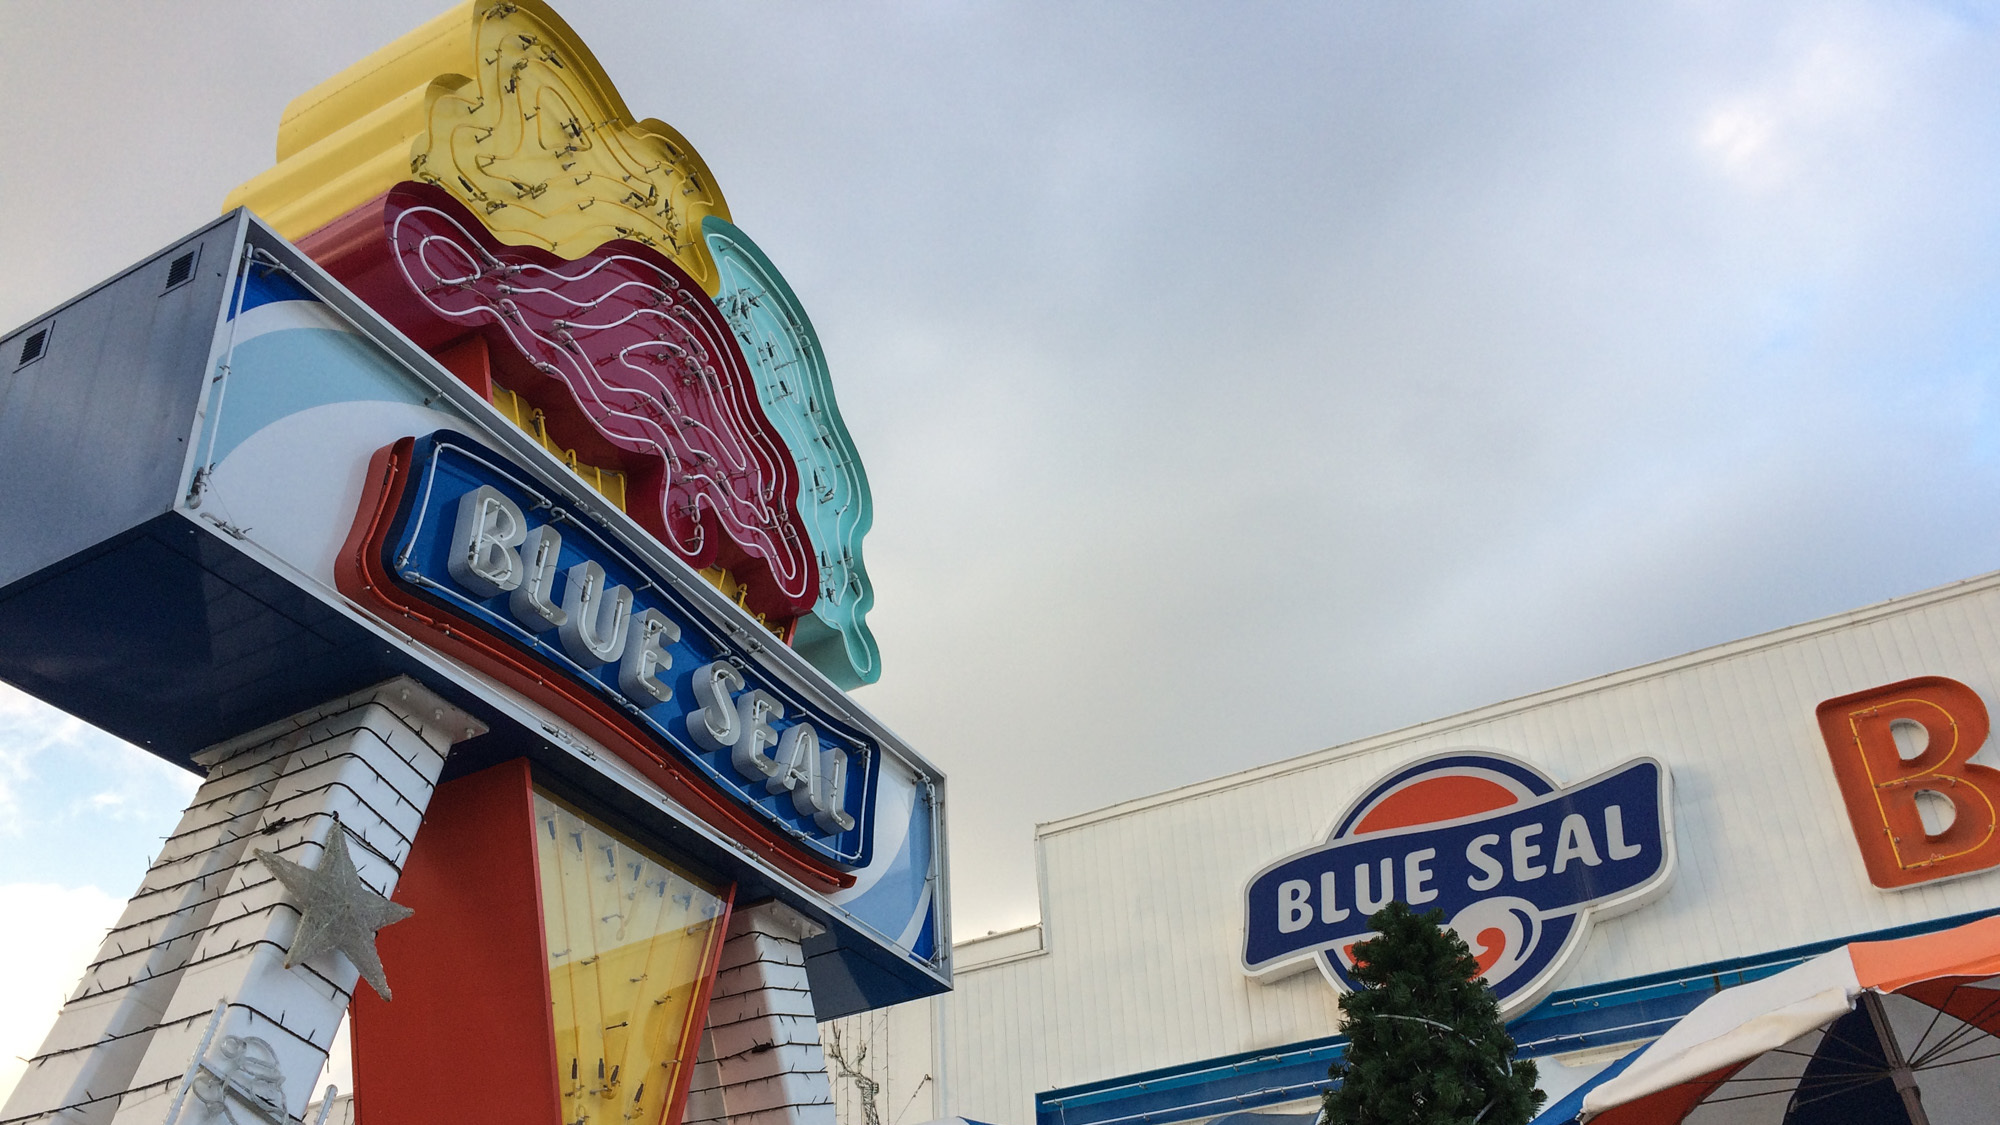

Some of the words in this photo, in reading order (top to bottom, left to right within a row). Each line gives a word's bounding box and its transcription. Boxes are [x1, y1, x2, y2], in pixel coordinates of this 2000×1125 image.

[447, 484, 682, 703] BLUE
[686, 660, 856, 835] SEAL
[1277, 847, 1439, 934] BLUE
[1465, 804, 1642, 892] SEAL
